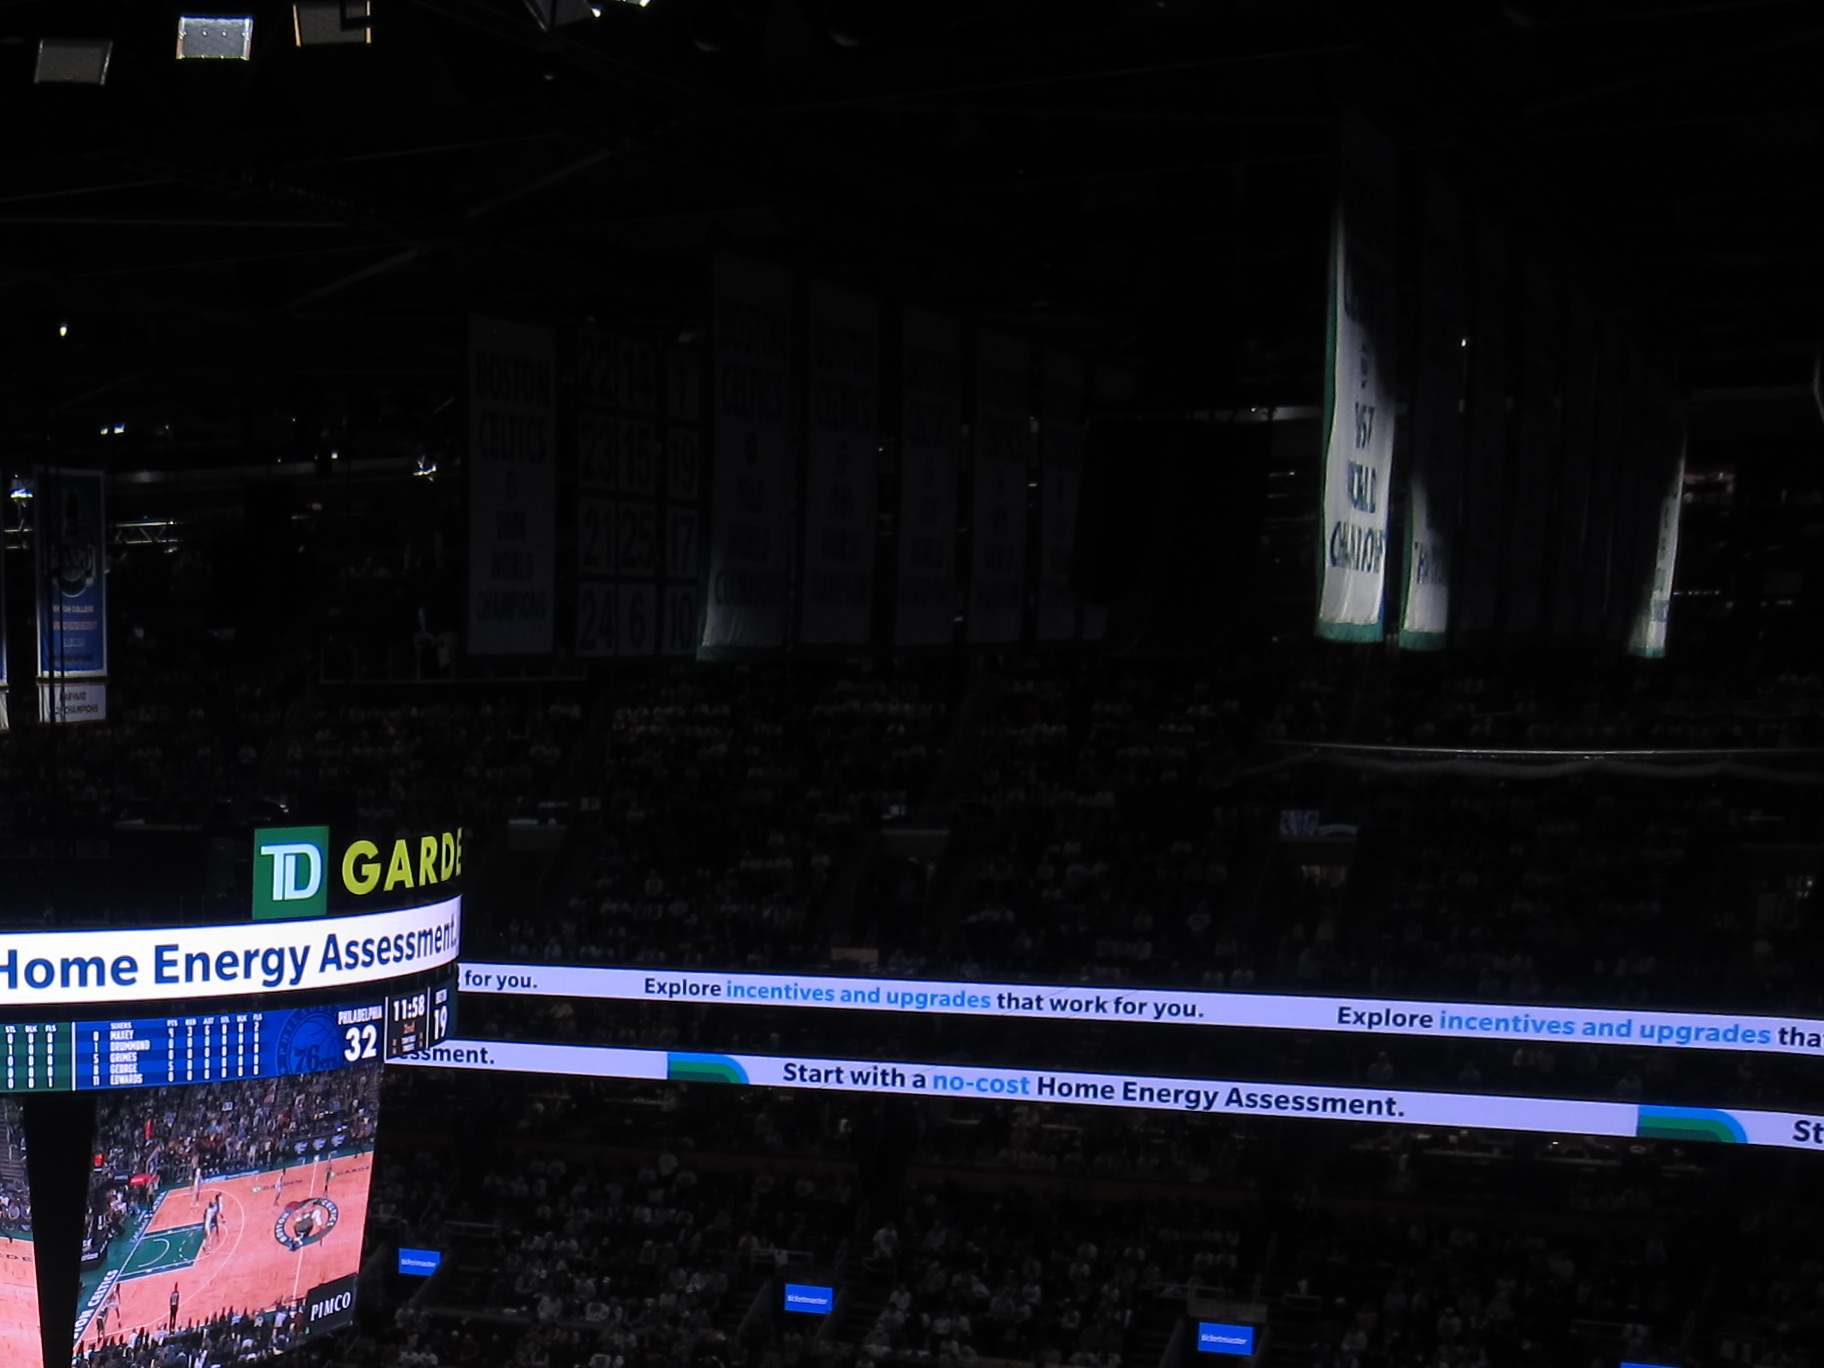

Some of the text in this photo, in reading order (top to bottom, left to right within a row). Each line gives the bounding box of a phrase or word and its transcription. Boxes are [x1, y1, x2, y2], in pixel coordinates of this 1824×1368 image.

[261, 827, 462, 900] TD GARDE
[154, 944, 310, 988] Energy
[319, 914, 459, 974] Assessment.
[464, 970, 538, 993] for you.
[644, 977, 1204, 1021] Explore incentives and upgrades that work for you.
[338, 1005, 383, 1025] PHILADELPHIA
[393, 993, 425, 1022] 11:58
[434, 1005, 448, 1040] 19
[344, 1024, 377, 1062] 32
[1337, 1006, 1824, 1049] Explore incentives and upgrades tha
[783, 1062, 1404, 1118] Start with a no-cost Home Energy Assessment.
[310, 1290, 352, 1322] PIMCO
